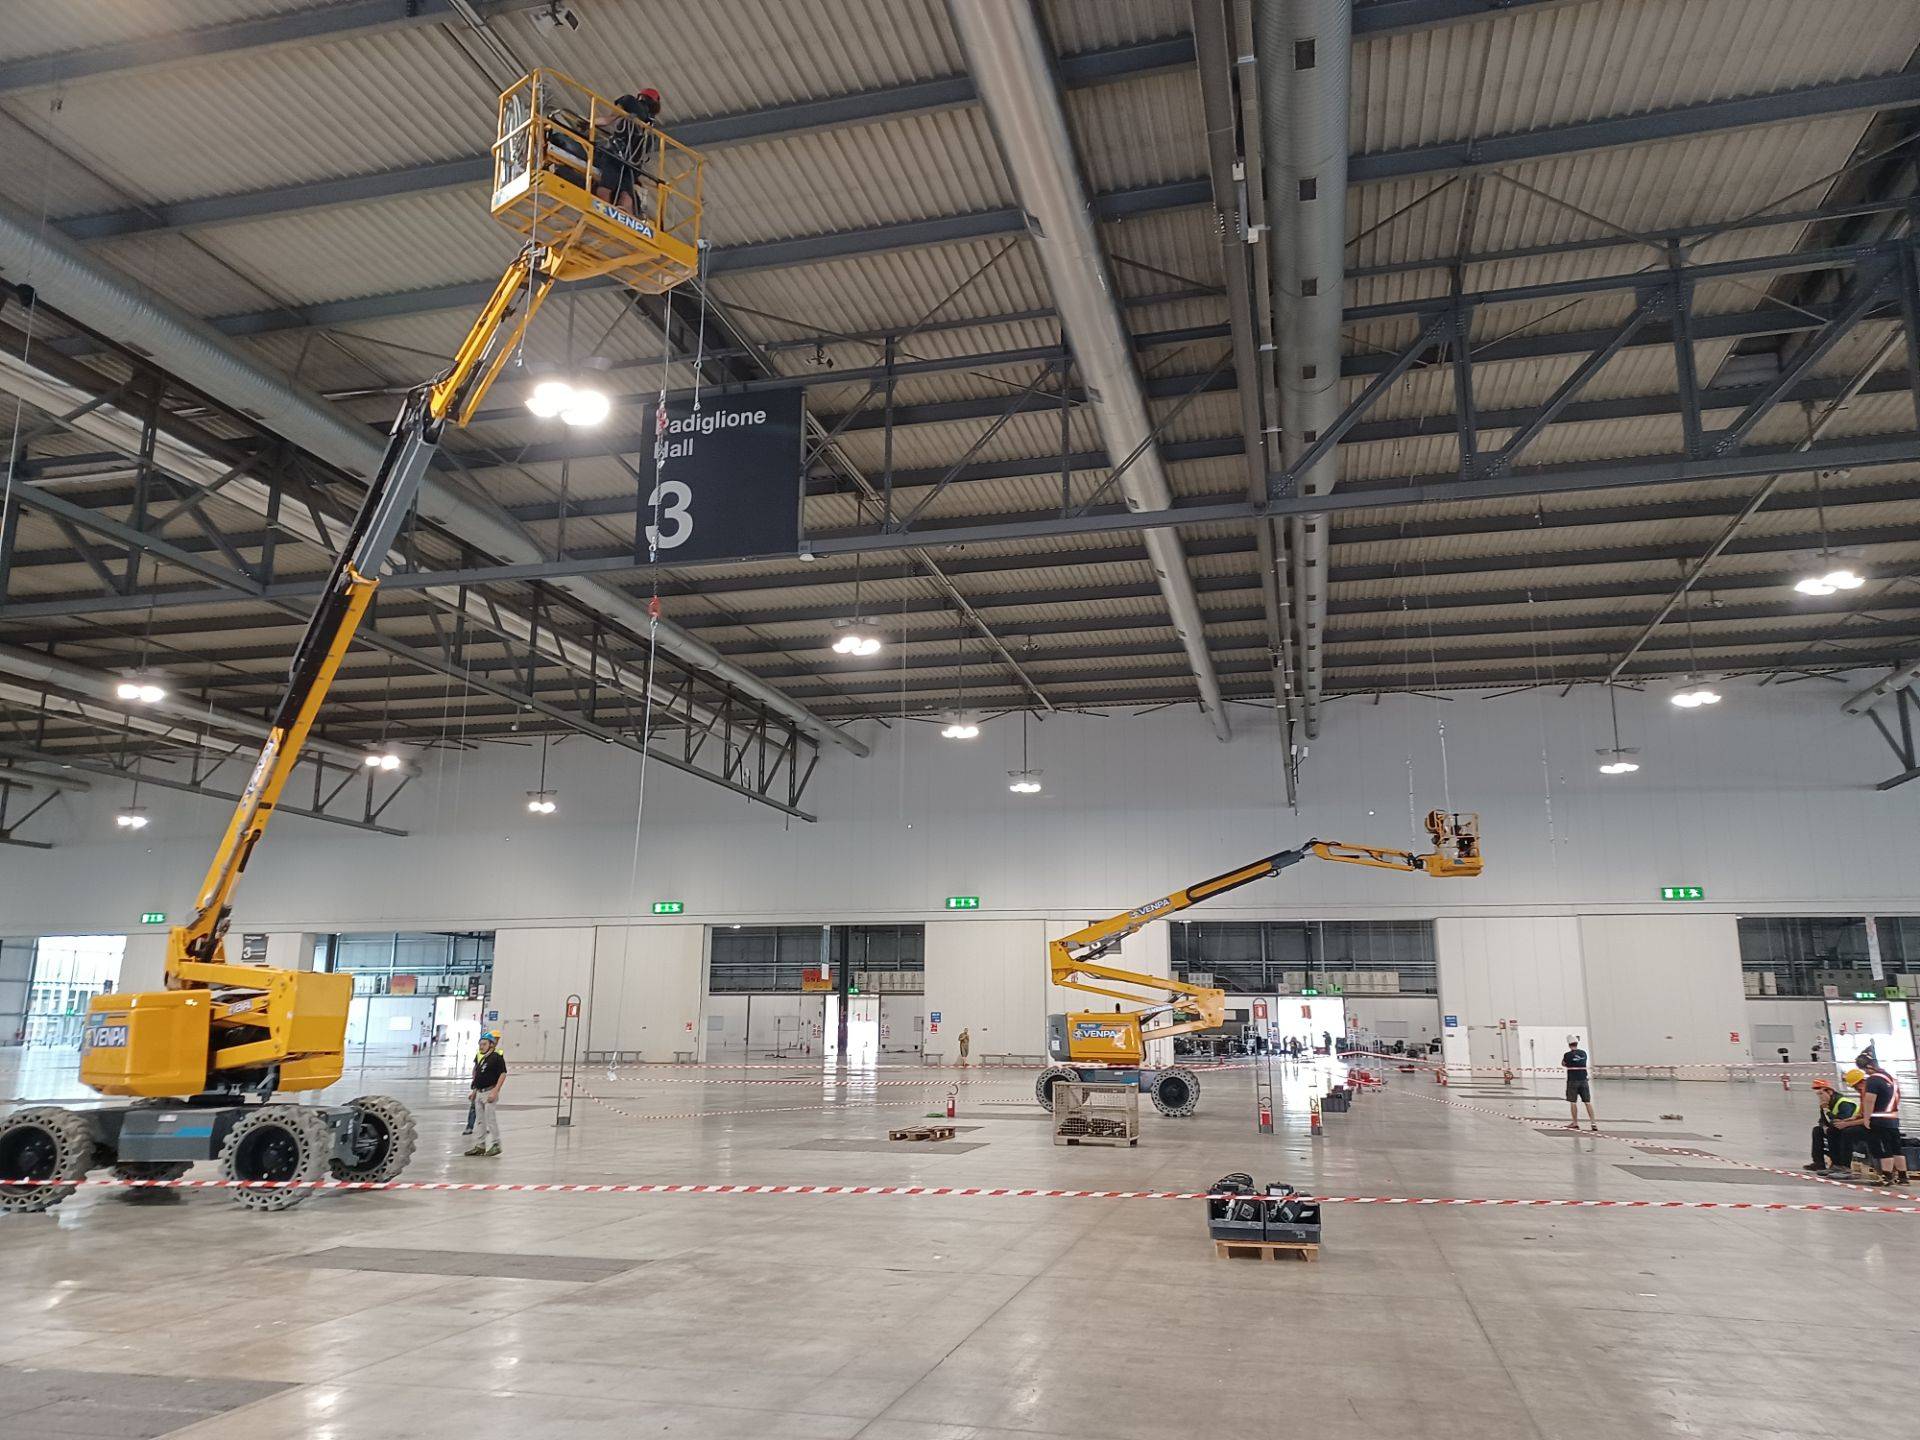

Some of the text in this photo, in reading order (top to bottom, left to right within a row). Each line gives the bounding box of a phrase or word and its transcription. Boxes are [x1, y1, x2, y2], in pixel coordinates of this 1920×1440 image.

[607, 206, 653, 239] VENPA
[656, 410, 767, 435] Padiglione
[653, 438, 694, 459] Hall
[645, 480, 694, 549] 3
[1139, 898, 1170, 915] VENPA
[243, 946, 252, 959] 3
[1083, 1029, 1117, 1038] VENPA
